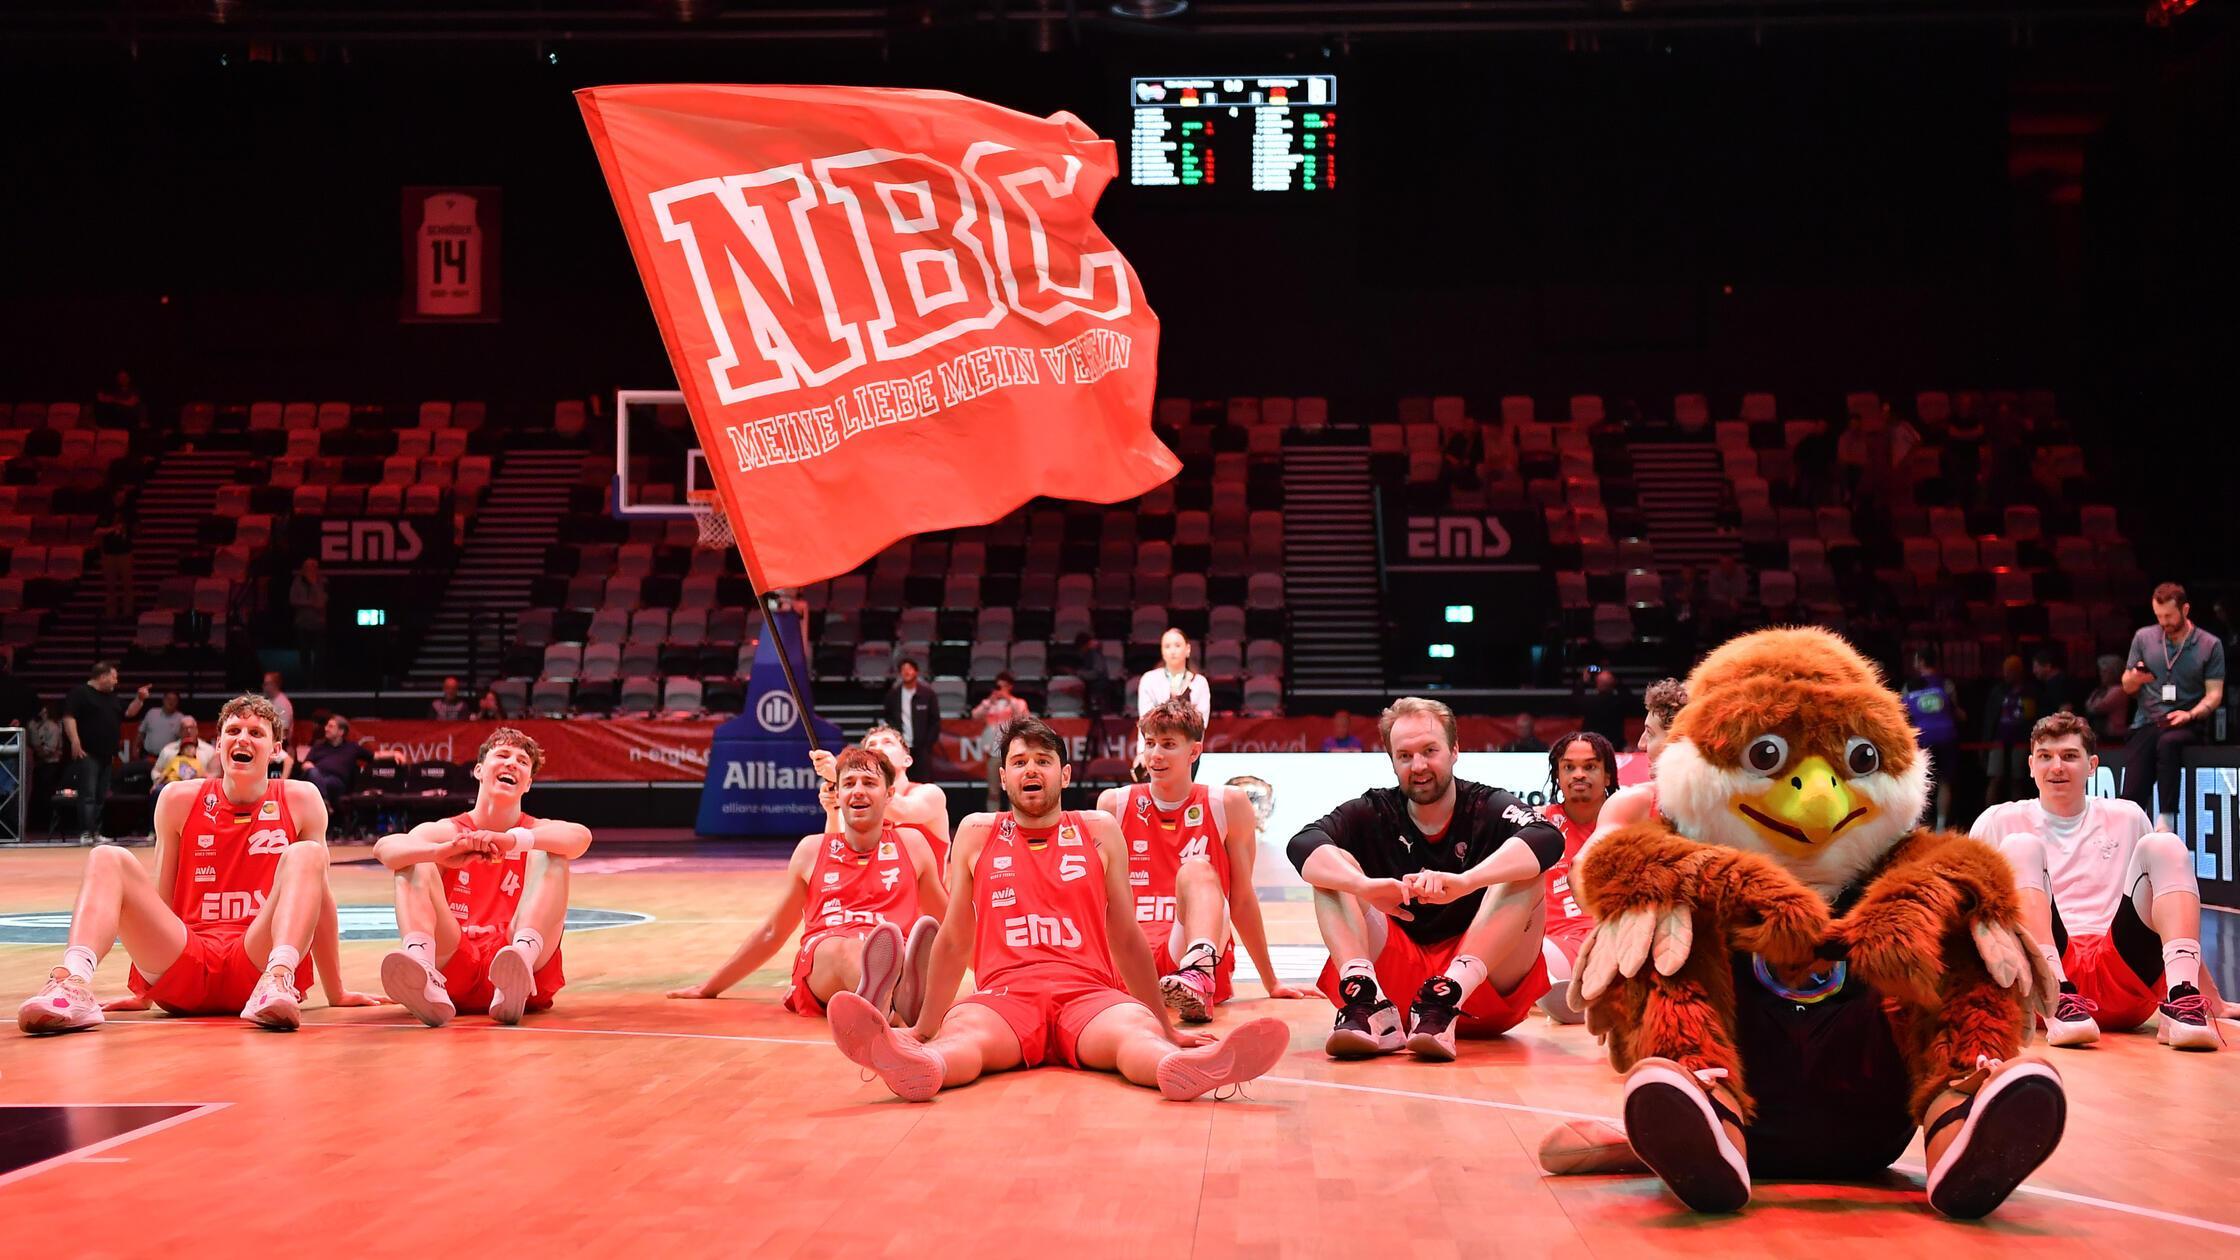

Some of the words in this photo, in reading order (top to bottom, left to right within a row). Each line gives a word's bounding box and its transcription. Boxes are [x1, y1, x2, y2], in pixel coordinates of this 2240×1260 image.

[431, 240, 467, 285] 14
[649, 141, 1132, 405] NBC
[726, 407, 840, 472] MEINE
[834, 369, 940, 440] LIEBE
[937, 345, 1040, 408] MEIN
[321, 521, 423, 561] EMS
[1407, 517, 1511, 558] EMS
[248, 828, 289, 856] 28
[880, 867, 901, 892] 7
[1060, 853, 1087, 881] 5
[500, 869, 521, 897] 4
[992, 887, 1015, 900] AVIA
[1136, 896, 1177, 921] EM
[1005, 913, 1082, 948] EMS
